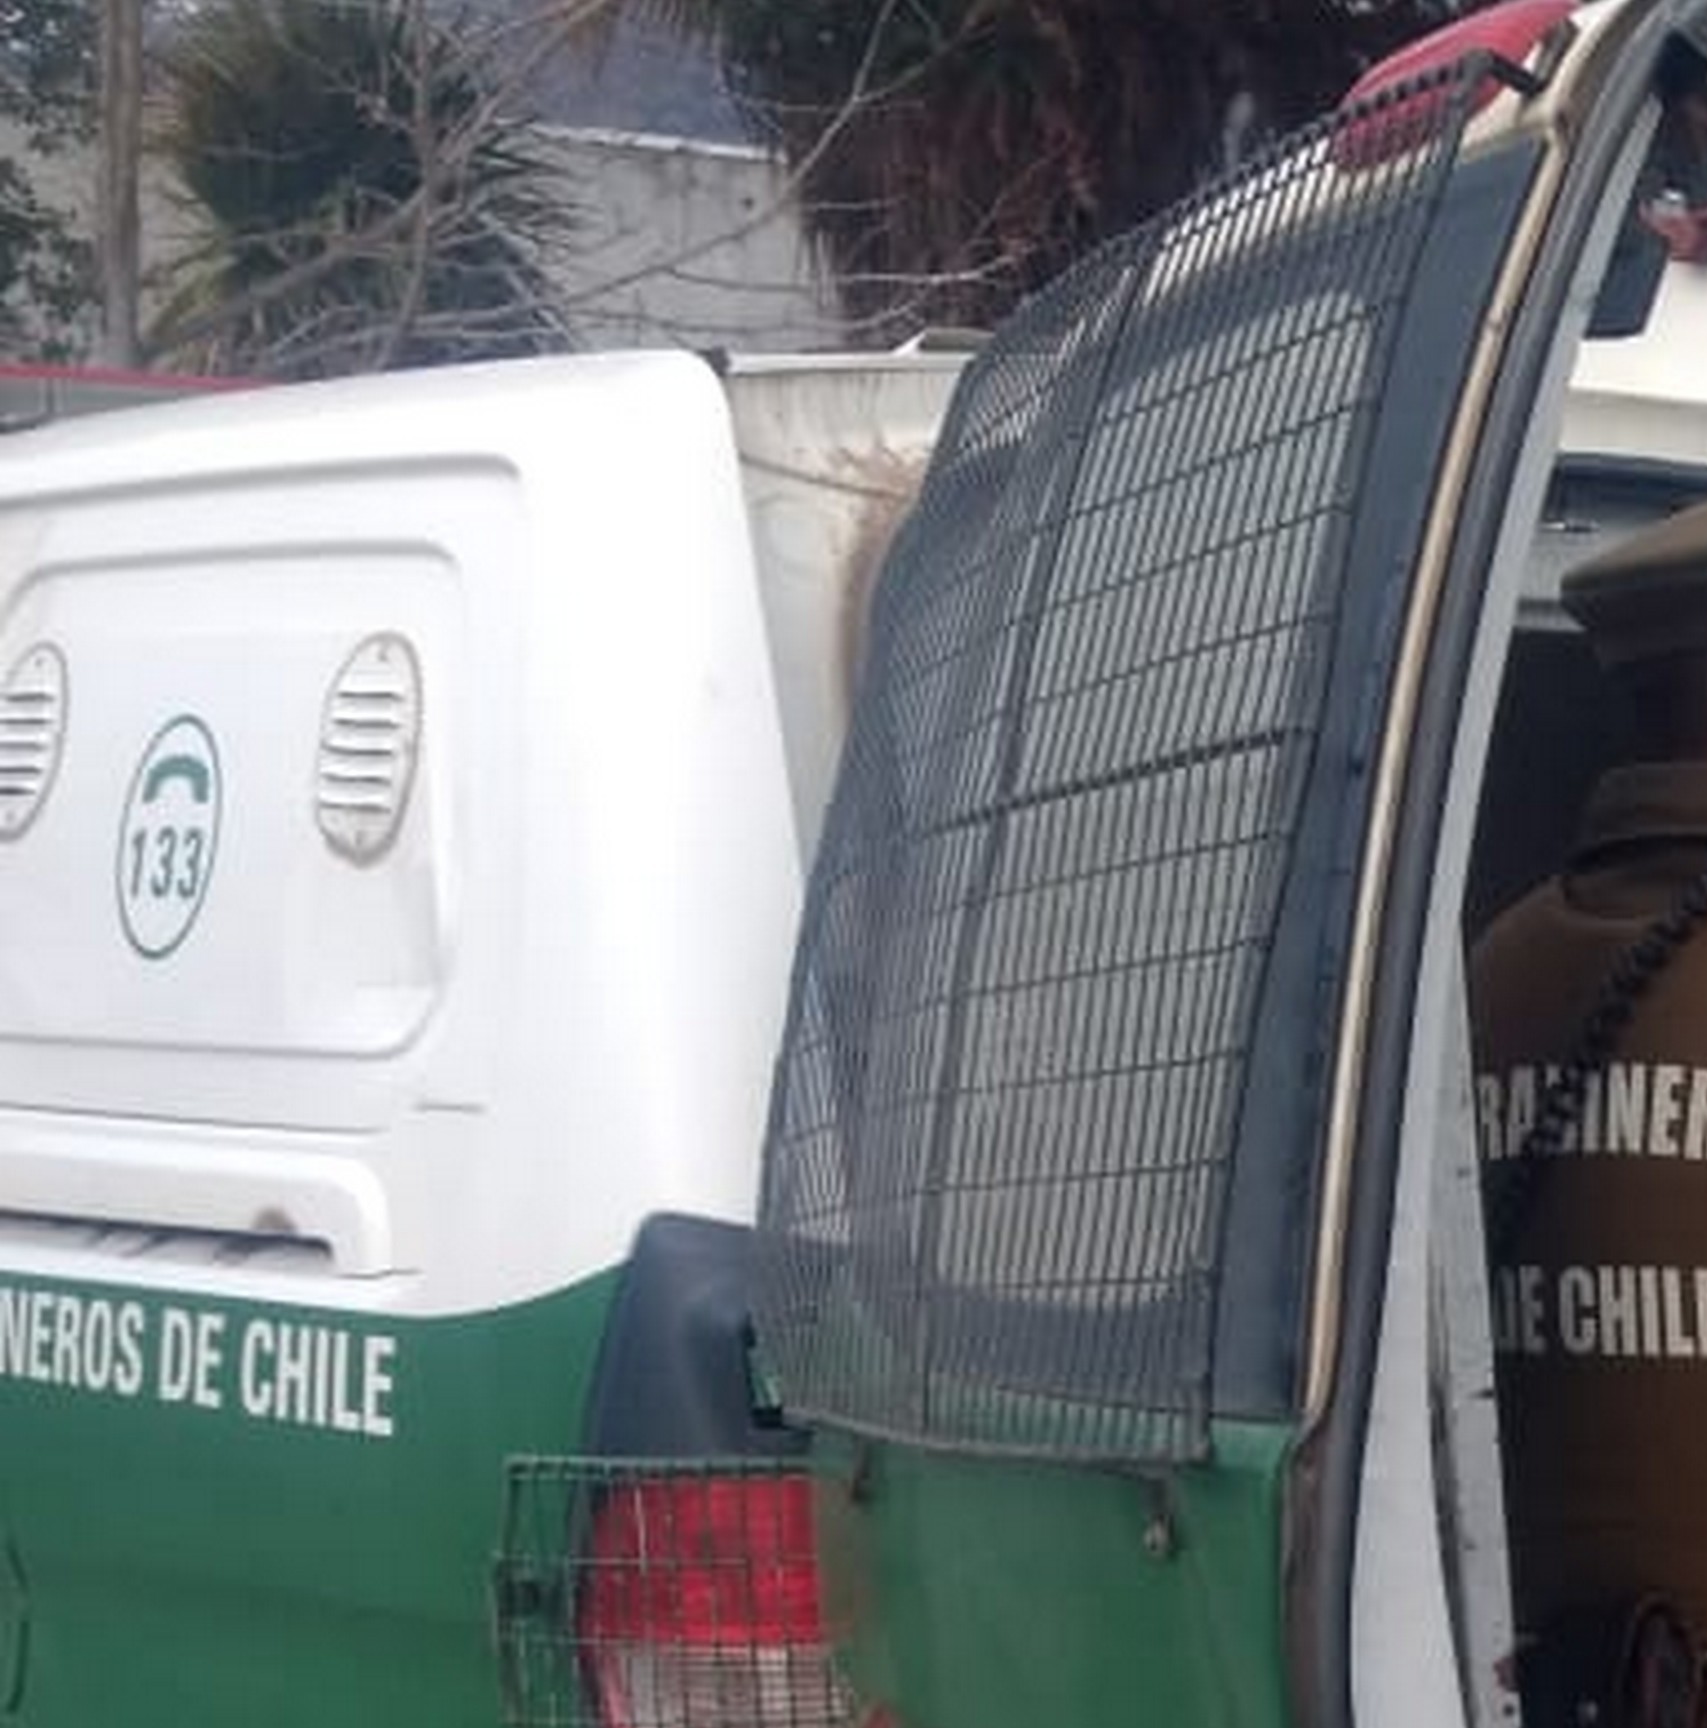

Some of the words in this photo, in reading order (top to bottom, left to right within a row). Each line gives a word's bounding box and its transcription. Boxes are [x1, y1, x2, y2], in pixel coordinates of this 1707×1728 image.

[130, 826, 203, 899] 133
[159, 1307, 226, 1409] DE
[241, 1320, 396, 1437] CHILE
